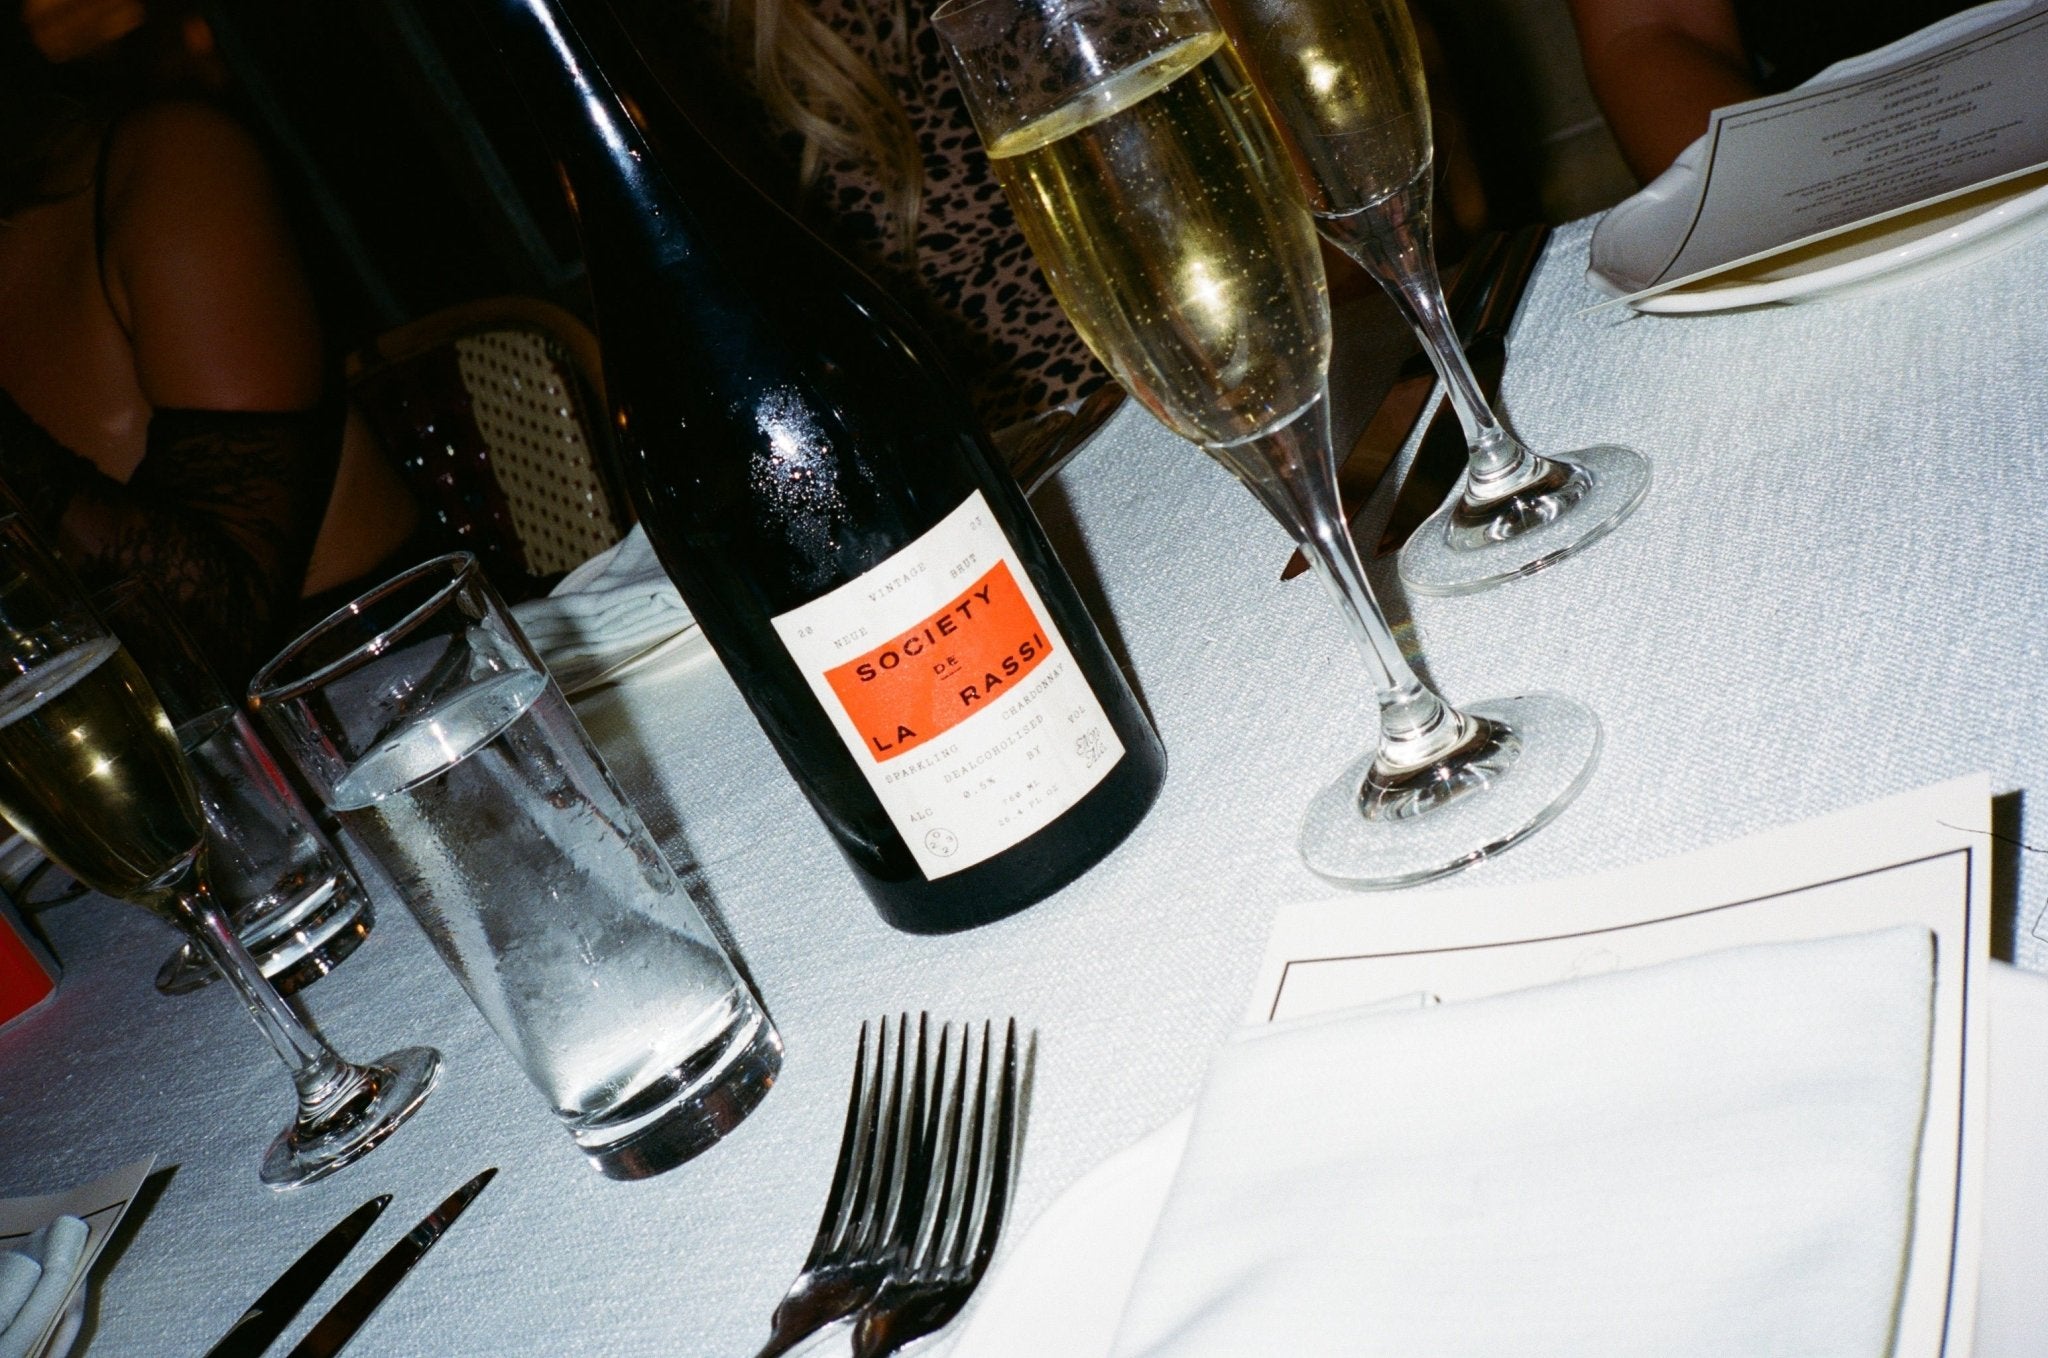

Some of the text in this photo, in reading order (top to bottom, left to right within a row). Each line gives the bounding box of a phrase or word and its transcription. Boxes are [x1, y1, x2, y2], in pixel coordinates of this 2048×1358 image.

[833, 553, 978, 649] NEUE BRUT
[868, 562, 927, 602] VINTAGE
[856, 584, 991, 682] SOCIETY
[933, 656, 959, 675] DE
[873, 633, 1044, 752] LA RASSI
[885, 662, 1064, 784] SPARKLING CHARDONNAY
[909, 808, 934, 823] ALC
[1026, 744, 1041, 760] BY
[943, 714, 1044, 783] DEALCOHOLISED
